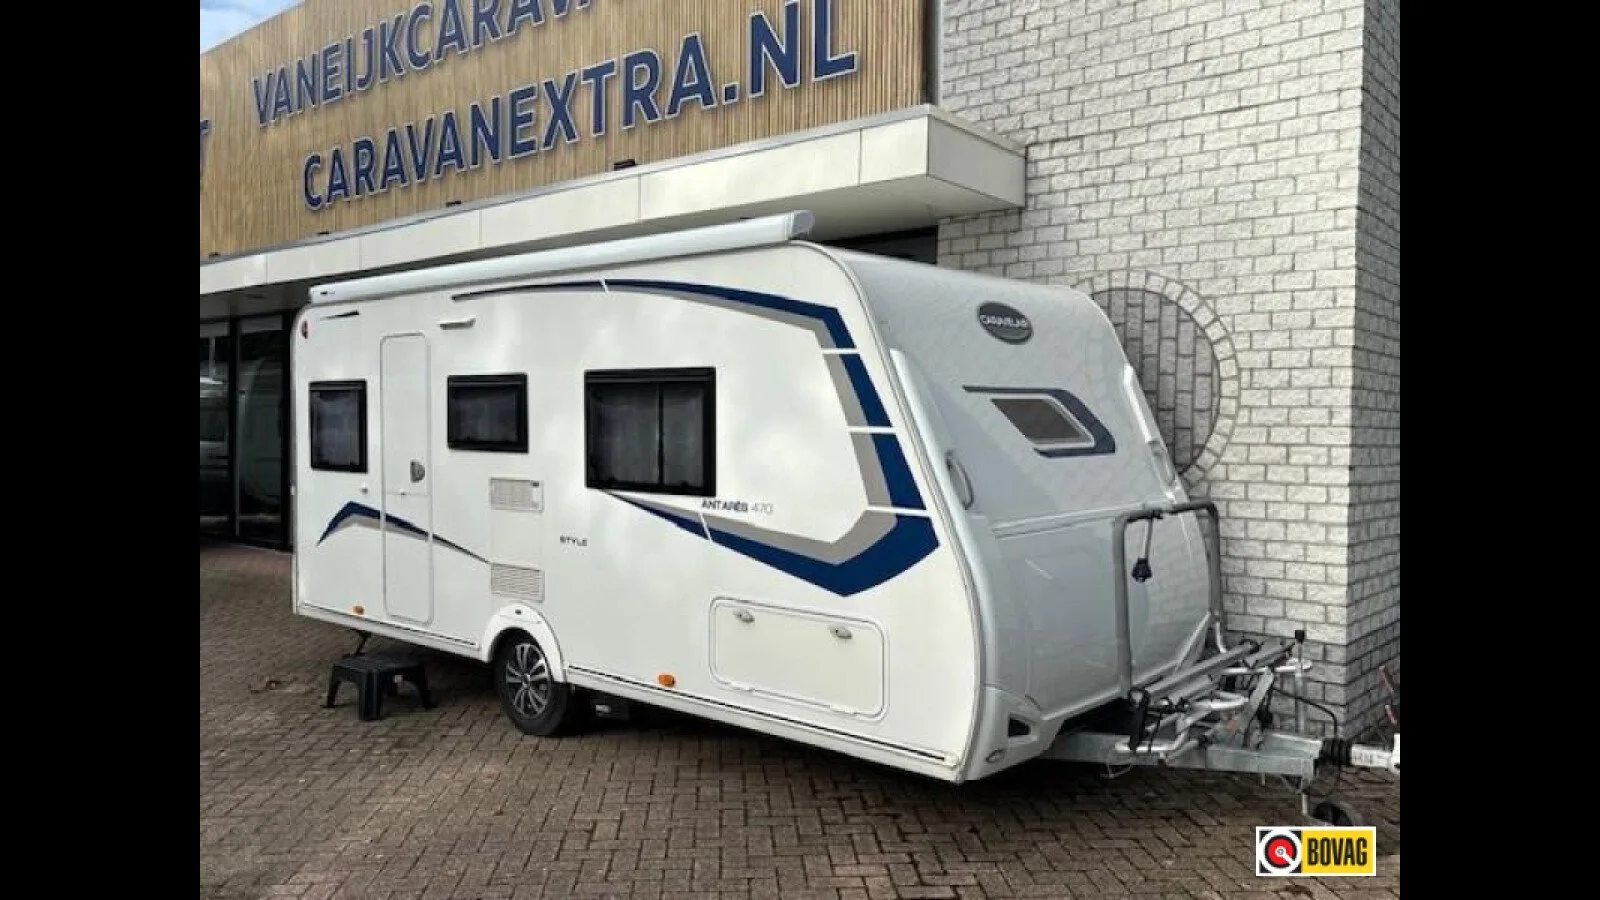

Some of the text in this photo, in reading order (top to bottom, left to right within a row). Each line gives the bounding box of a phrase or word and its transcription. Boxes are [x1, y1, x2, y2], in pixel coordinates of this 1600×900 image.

[252, 0, 591, 127] VANEIJKCARA
[303, 0, 857, 210] CARAVANEXTRA.NL
[559, 536, 588, 547] STYLE
[751, 502, 775, 515] 470
